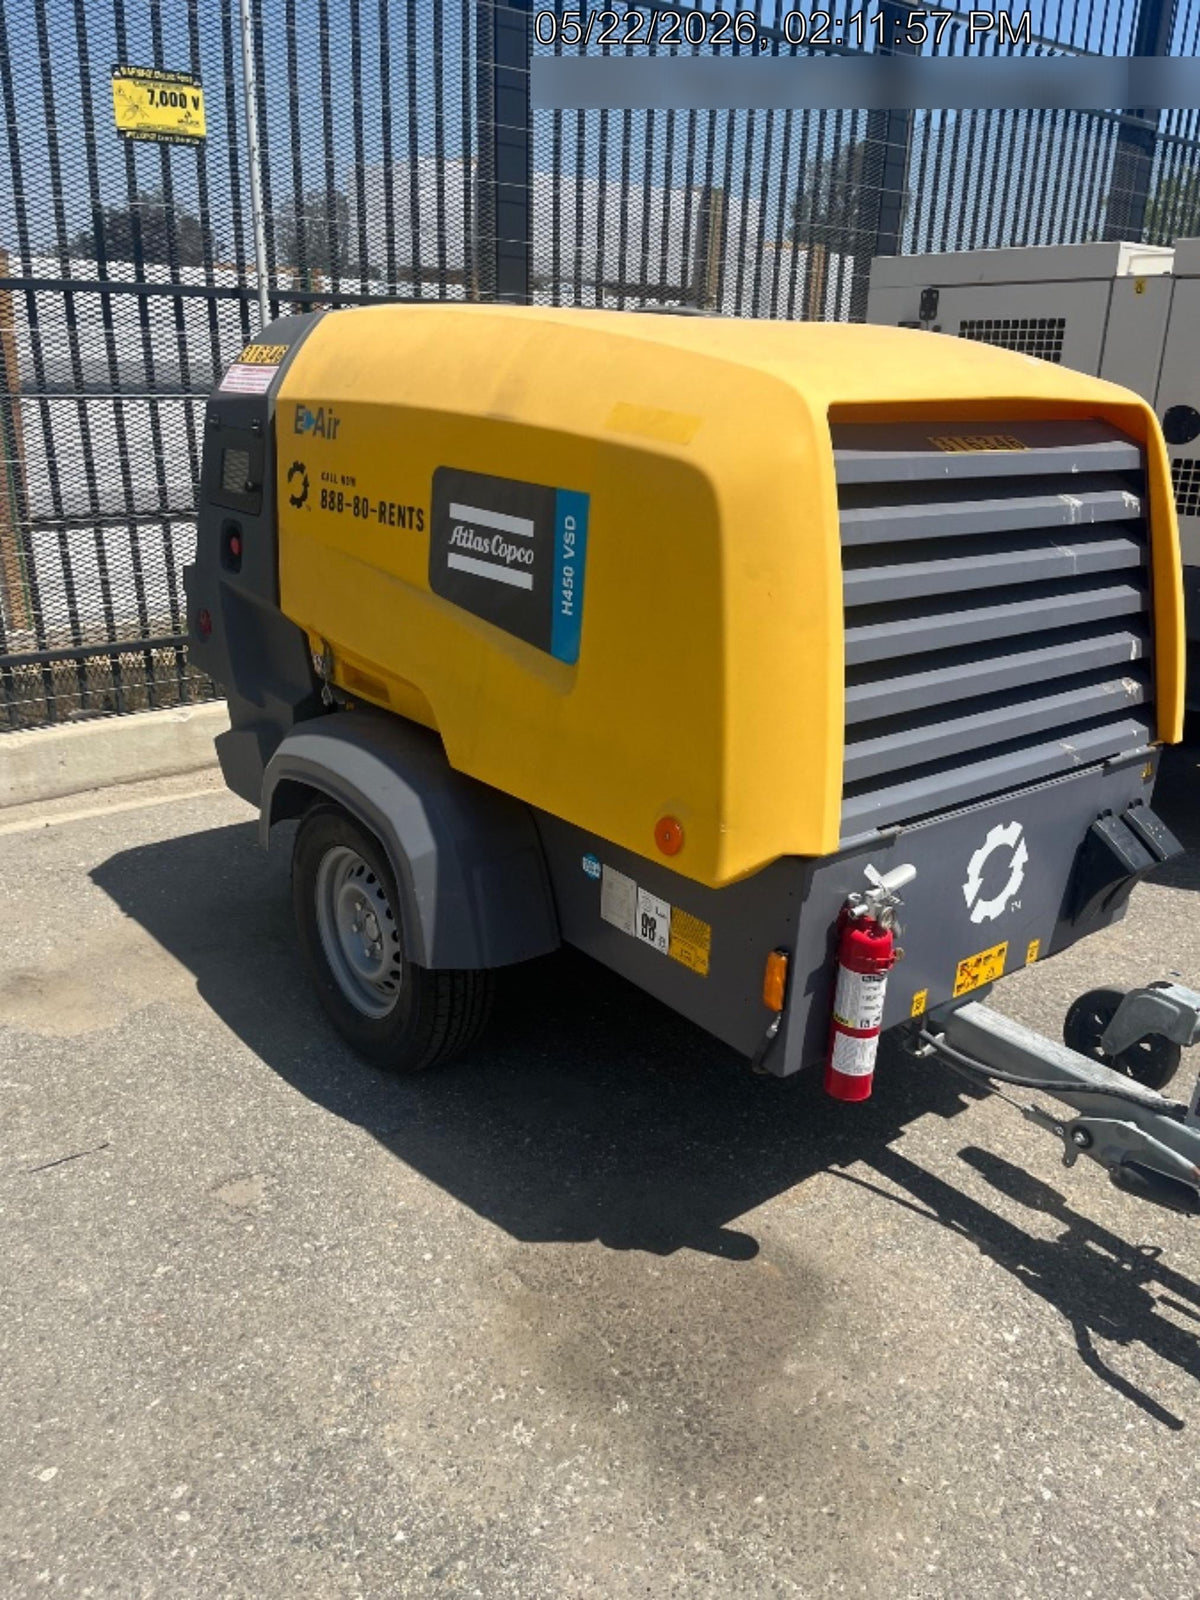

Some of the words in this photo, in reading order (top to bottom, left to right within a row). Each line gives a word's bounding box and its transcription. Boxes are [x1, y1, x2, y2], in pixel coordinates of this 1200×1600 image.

[147, 88, 187, 109] 7,000
[191, 95, 200, 111] V
[321, 471, 338, 484] CALL
[341, 475, 356, 487] NOW
[321, 488, 424, 532] 888-80-RENTS
[449, 525, 490, 553] Atlas
[490, 534, 534, 564] Copco
[563, 515, 577, 559] VSD
[561, 566, 575, 616] H450
